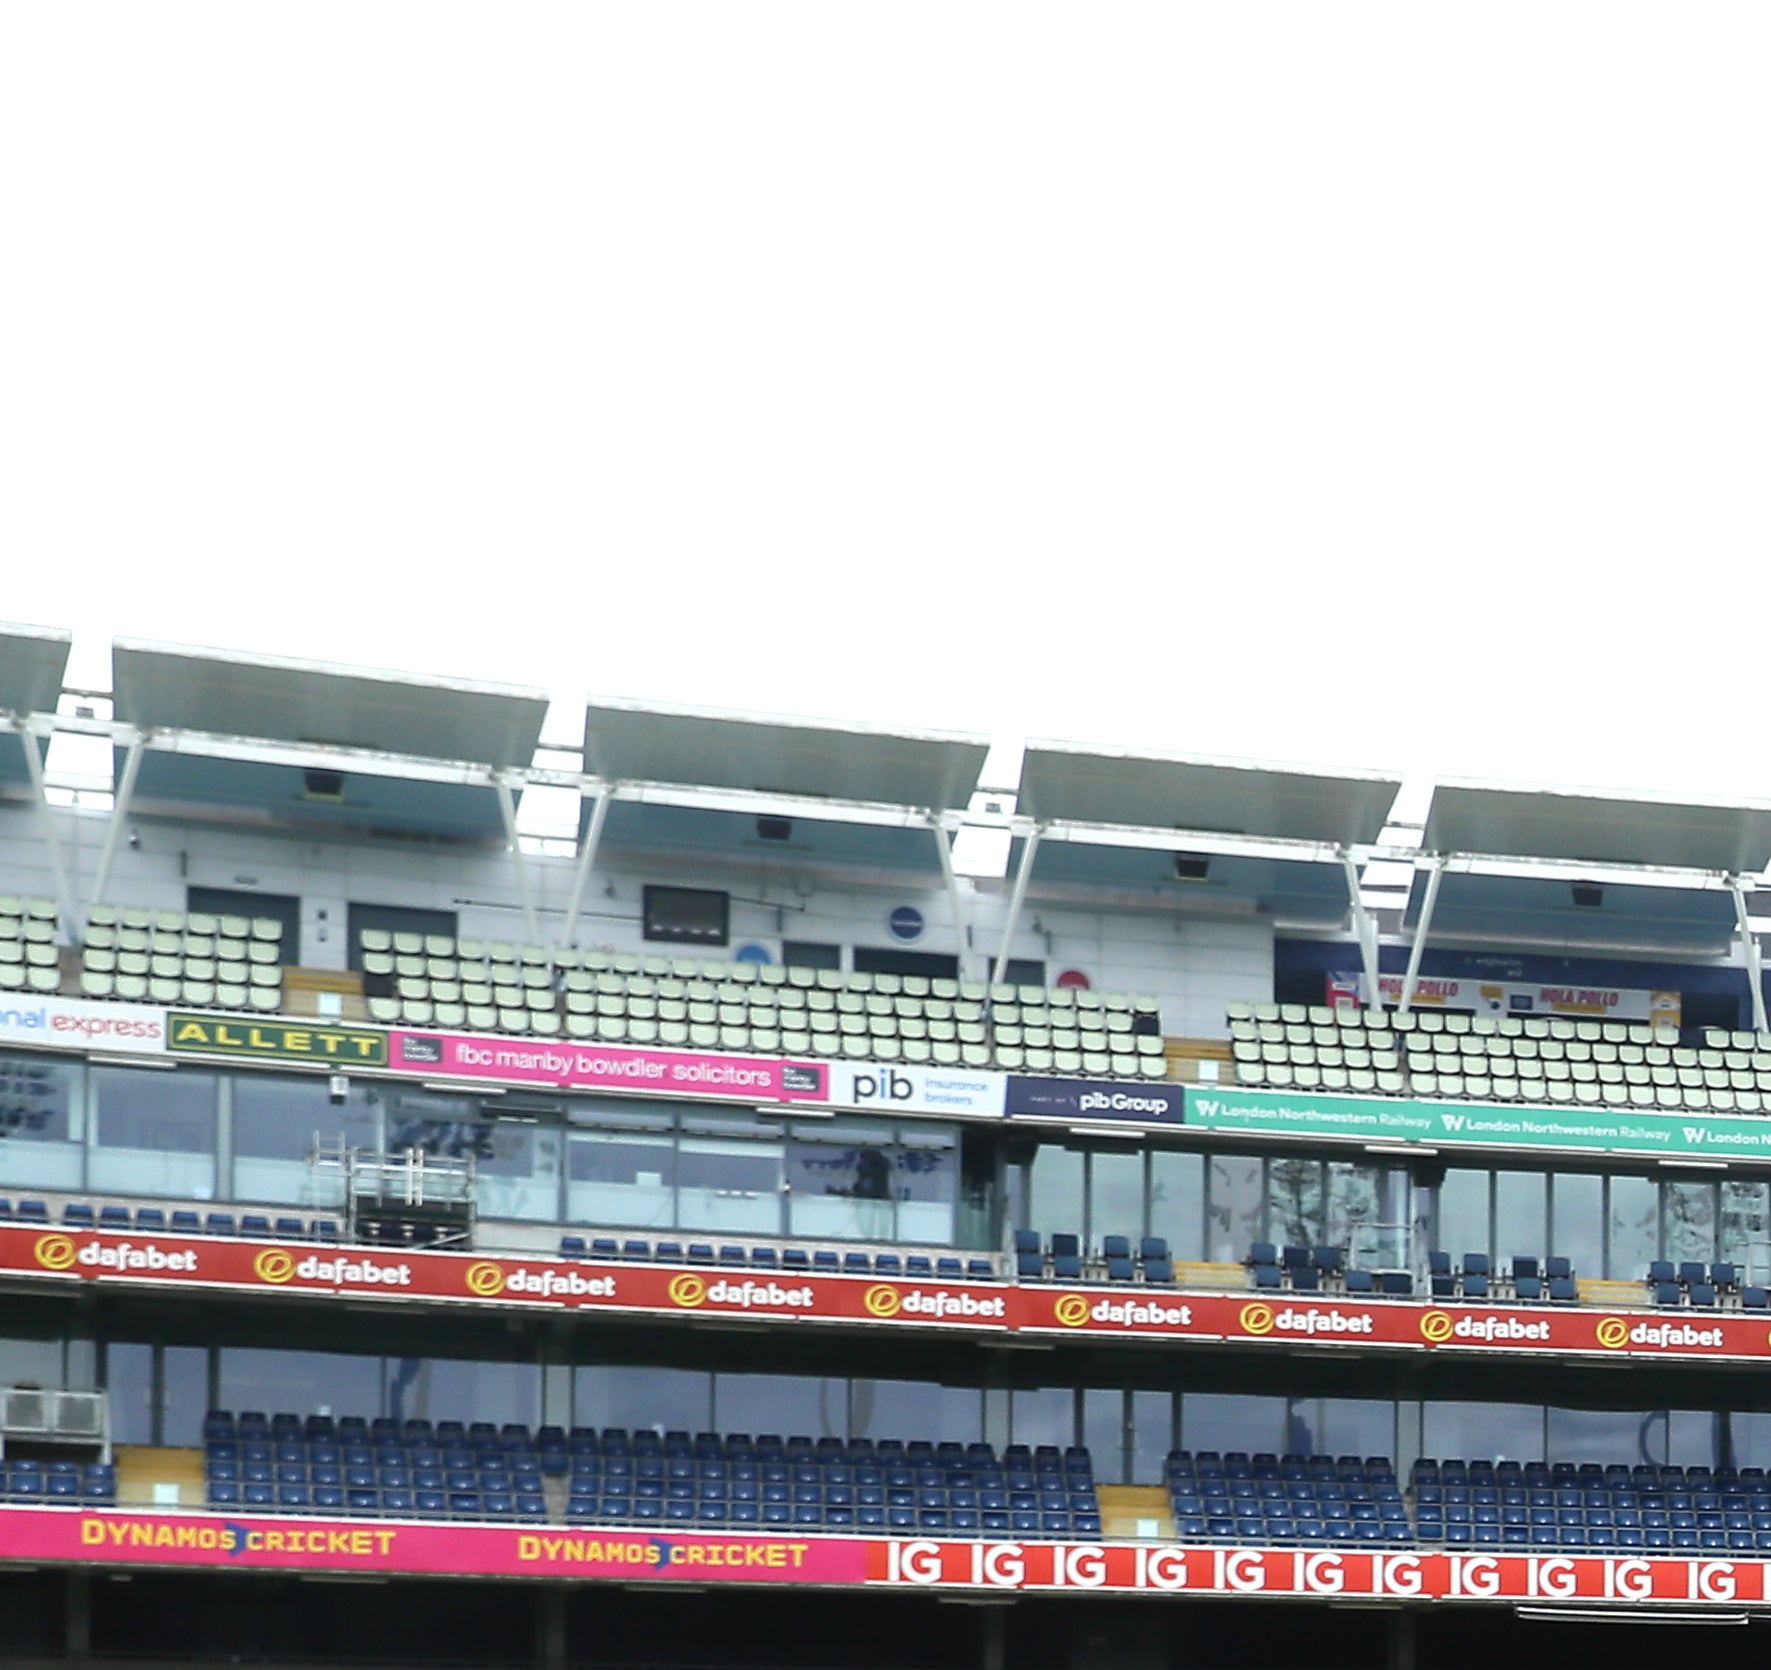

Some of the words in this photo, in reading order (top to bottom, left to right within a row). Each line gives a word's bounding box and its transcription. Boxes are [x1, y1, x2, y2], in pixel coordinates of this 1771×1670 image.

[1579, 991, 1619, 1007] POLLO
[53, 1014, 162, 1038] express
[176, 1022, 379, 1056] ALLETT
[456, 1042, 493, 1066] fbc
[495, 1048, 574, 1076] manby
[577, 1050, 667, 1080] bowdler
[672, 1061, 772, 1088] solicitors
[852, 1068, 913, 1104] pib
[925, 1077, 989, 1093] insurance
[925, 1091, 974, 1107] brokers
[1221, 1104, 1277, 1118] London
[1279, 1105, 1376, 1124] Northwestern
[1379, 1113, 1432, 1130] Railway
[1466, 1118, 1521, 1133] London
[1523, 1121, 1617, 1138] Northwestern
[1620, 1127, 1671, 1143] Railway
[1707, 1132, 1759, 1146] London
[77, 1239, 198, 1270] dafabet
[296, 1255, 412, 1285] dafabet
[505, 1268, 616, 1297] dafabet
[706, 1279, 814, 1308] dafabet
[900, 1289, 1006, 1318] dafabet
[1090, 1300, 1192, 1327] dafabet
[1274, 1307, 1374, 1335] dafabet
[1454, 1314, 1551, 1342] dafabet
[1629, 1321, 1724, 1349] dafabet
[81, 1519, 236, 1549] DYNAMOS
[246, 1530, 396, 1556] CRICKET
[518, 1536, 661, 1565] DYNAMOS
[669, 1543, 808, 1569] CRICKET
[889, 1541, 941, 1584] IG
[973, 1543, 1024, 1585] IG
[1055, 1545, 1106, 1587] IG
[1136, 1547, 1187, 1589] IG
[1216, 1549, 1265, 1592] IG
[1294, 1551, 1344, 1592] IG
[1373, 1553, 1422, 1595] IG
[1450, 1556, 1500, 1596] IG
[1528, 1557, 1576, 1598] IG
[1605, 1558, 1653, 1599] IG
[1689, 1561, 1735, 1600] IG
